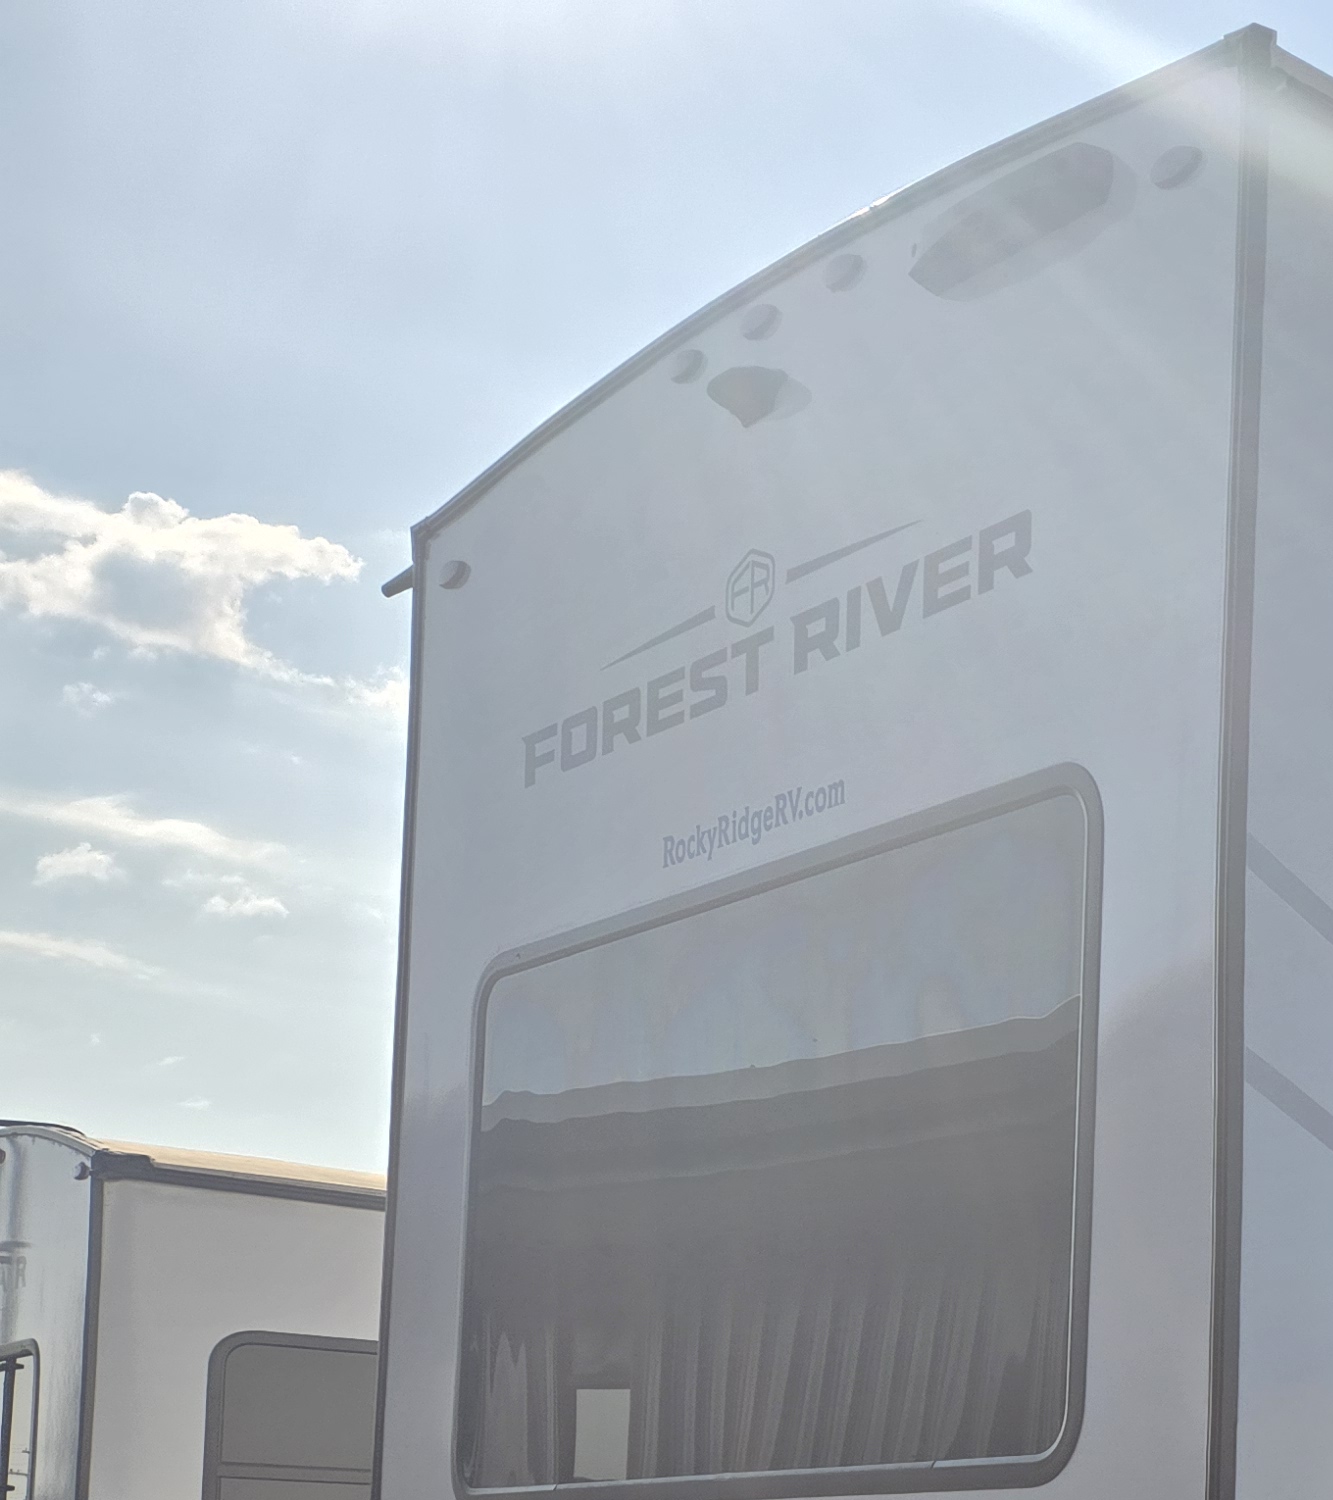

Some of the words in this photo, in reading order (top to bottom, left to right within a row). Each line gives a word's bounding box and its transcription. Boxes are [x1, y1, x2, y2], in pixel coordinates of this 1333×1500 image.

[521, 625, 775, 788] FOREST
[789, 508, 1034, 676] RIVER
[662, 779, 846, 869] RockyRidgeRV.com
